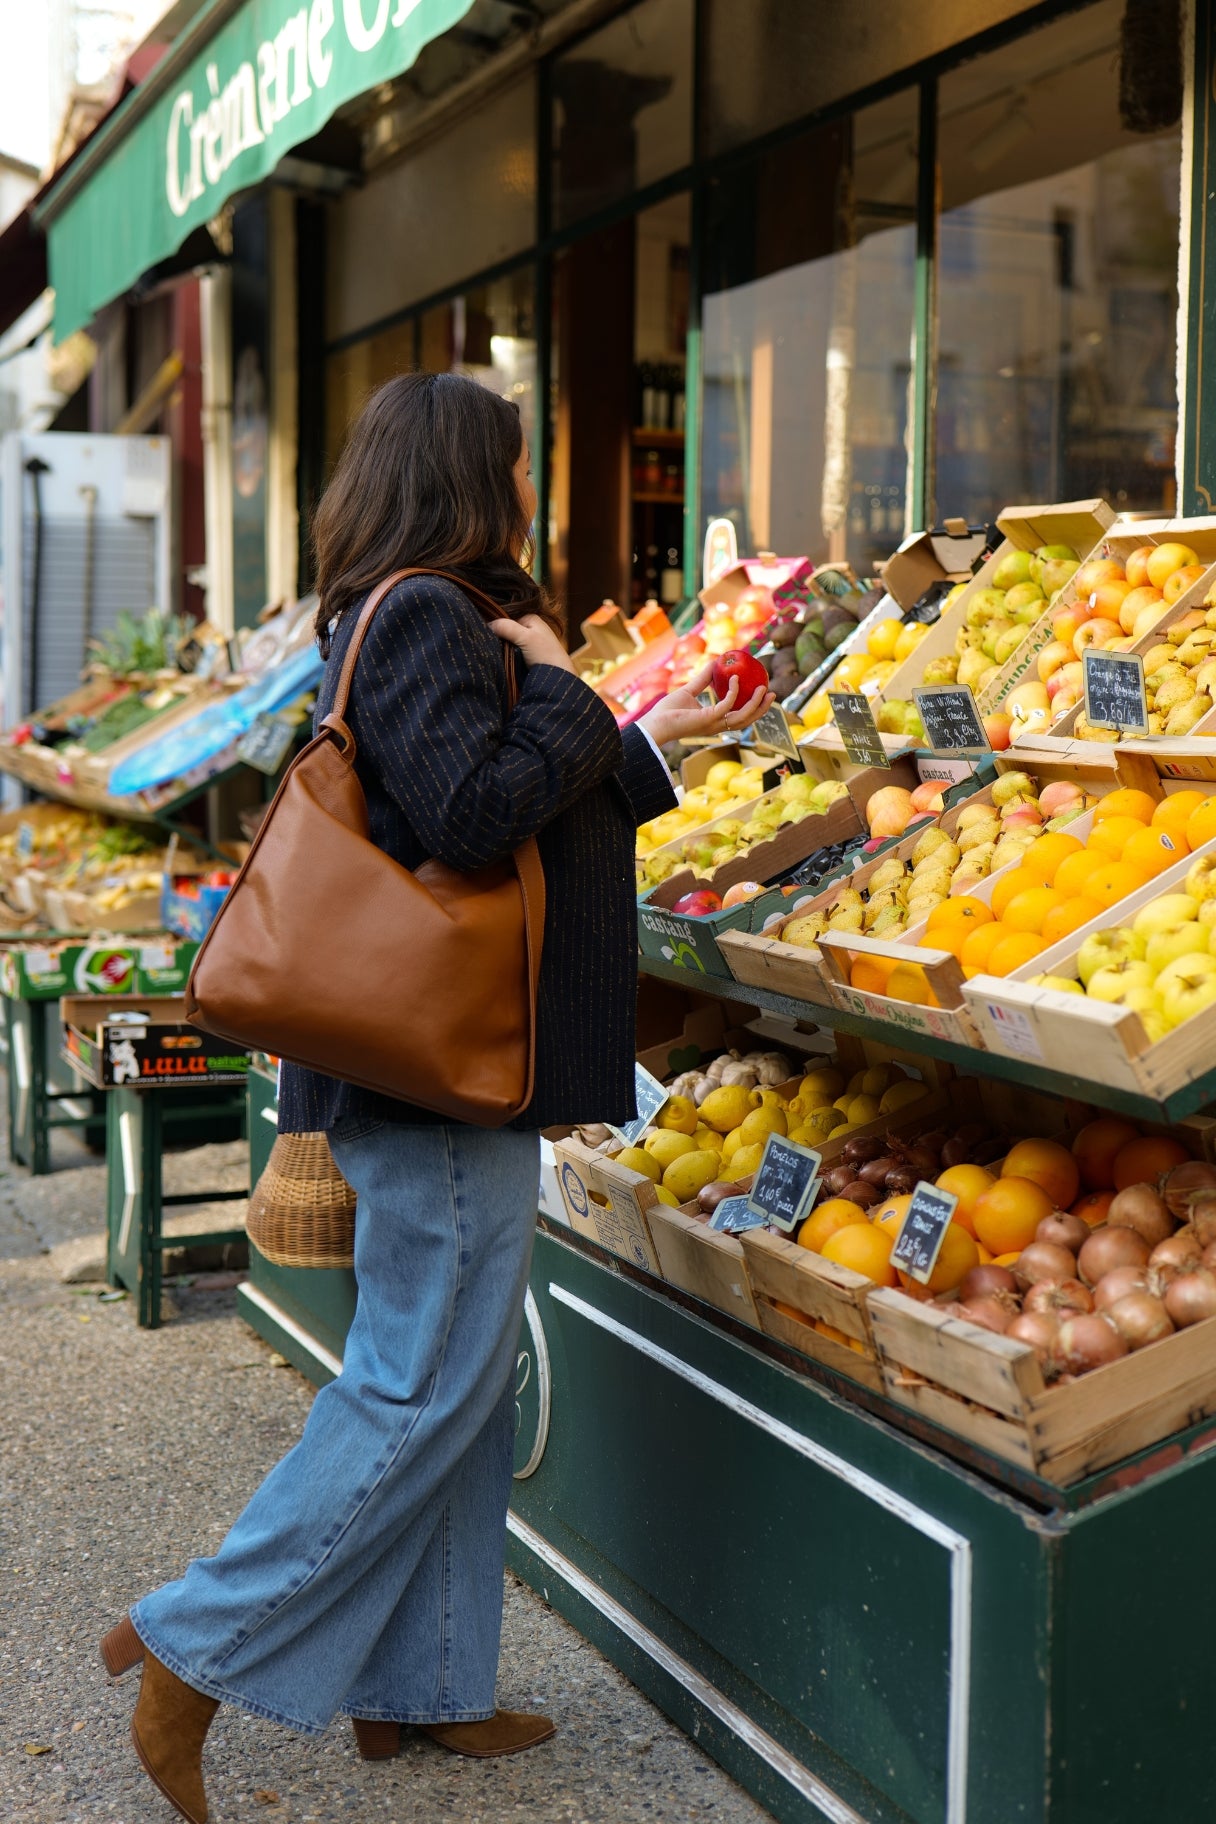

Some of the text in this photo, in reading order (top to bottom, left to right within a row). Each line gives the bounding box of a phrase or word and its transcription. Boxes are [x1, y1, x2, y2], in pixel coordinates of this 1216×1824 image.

[922, 768, 956, 783] castang
[641, 914, 697, 947] castang
[142, 1055, 208, 1076] LULU
[769, 1143, 800, 1169] POMELOS
